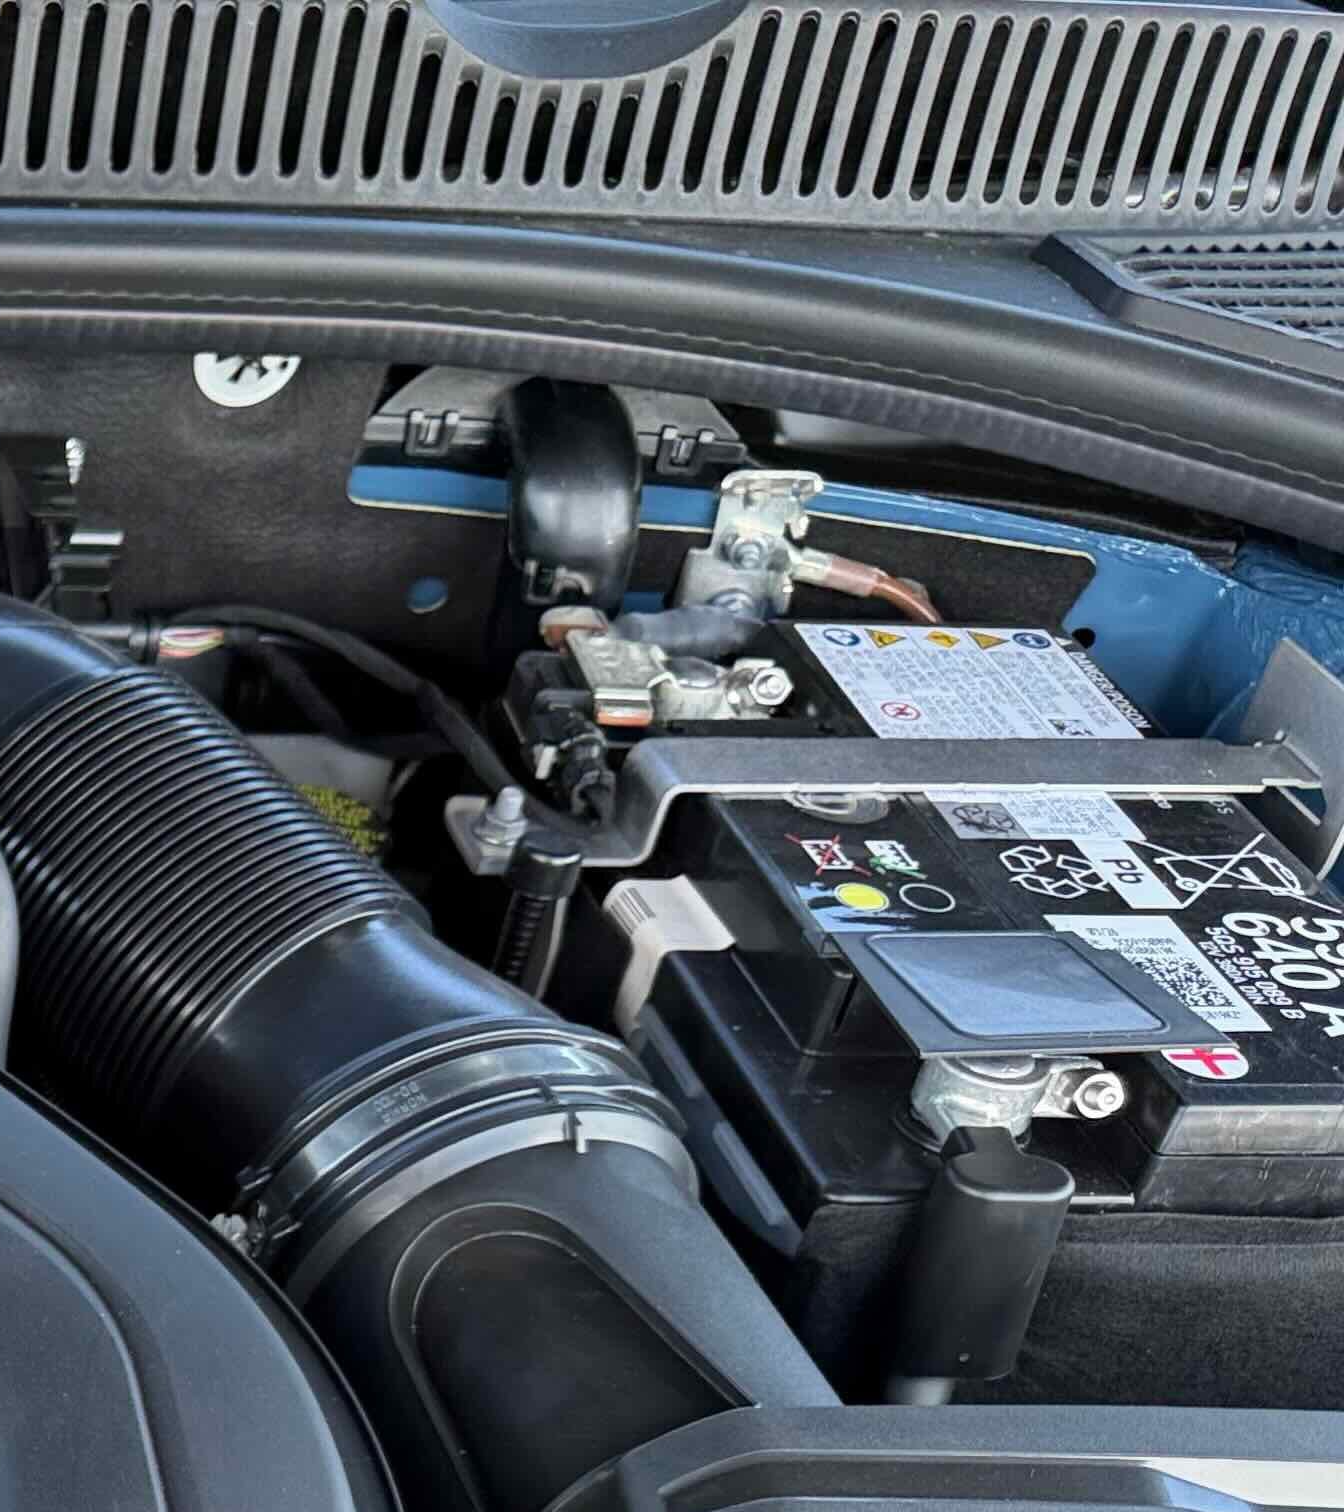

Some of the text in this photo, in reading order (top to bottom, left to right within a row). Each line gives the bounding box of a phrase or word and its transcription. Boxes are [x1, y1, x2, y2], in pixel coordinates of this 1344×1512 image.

[1103, 859, 1144, 885] Pb
[1222, 912, 1341, 990] 640
[1233, 956, 1268, 980] 915
[1255, 980, 1294, 1007] 089
